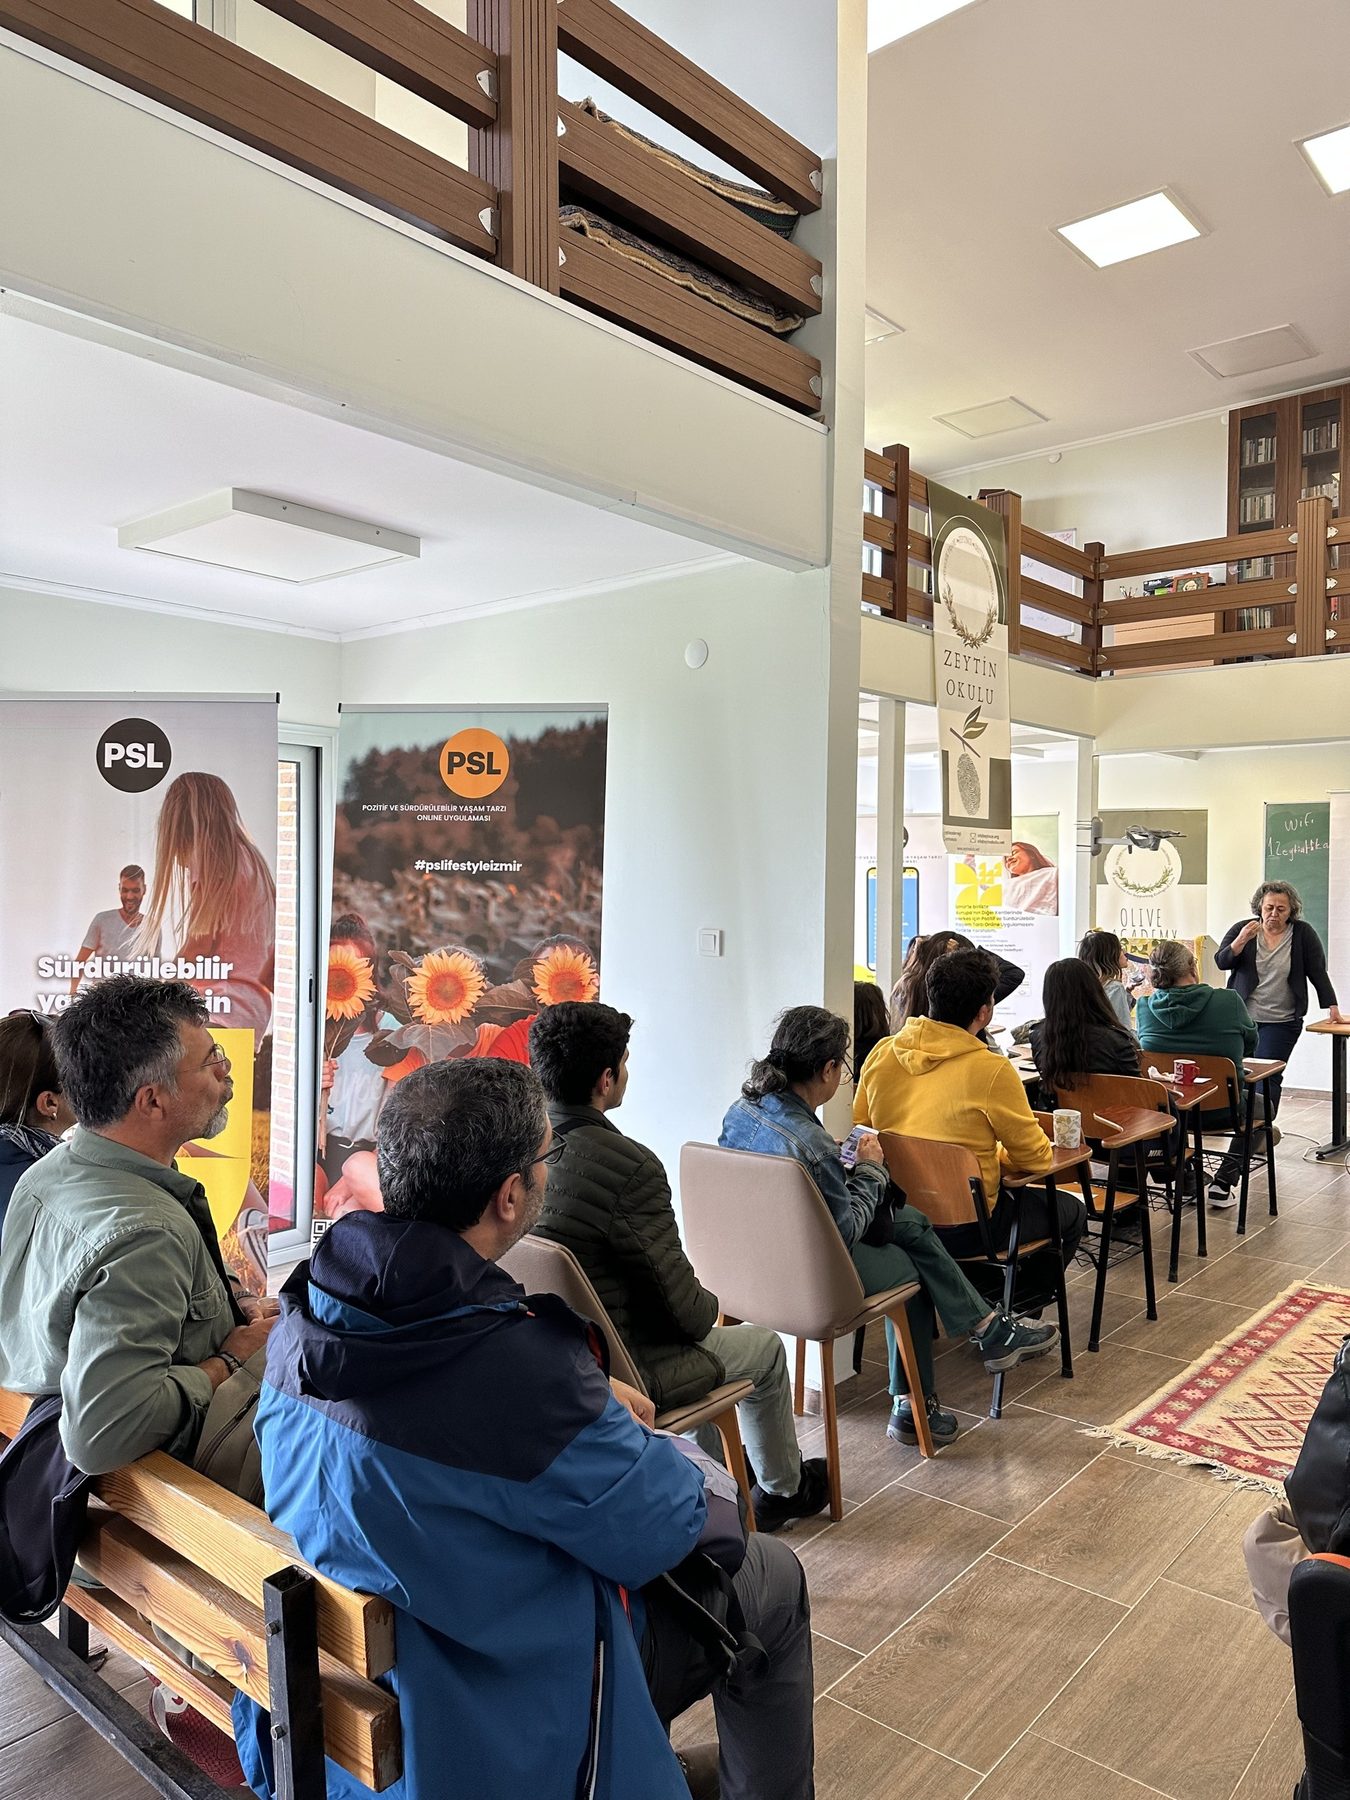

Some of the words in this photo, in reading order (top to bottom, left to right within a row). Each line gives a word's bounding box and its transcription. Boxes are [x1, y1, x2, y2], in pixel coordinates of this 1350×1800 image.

[943, 649, 997, 679] ZEYTİN
[946, 678, 994, 705] OKULU
[104, 742, 164, 769] PSL
[447, 751, 502, 775] PSL
[389, 804, 398, 812] VE
[459, 805, 485, 814] YAŞAM
[443, 814, 491, 822] UYGULAMASI
[414, 859, 523, 875] #pslifestyleizmir
[1120, 907, 1162, 928] OLIVE
[38, 955, 234, 980] Sürdürülebilir
